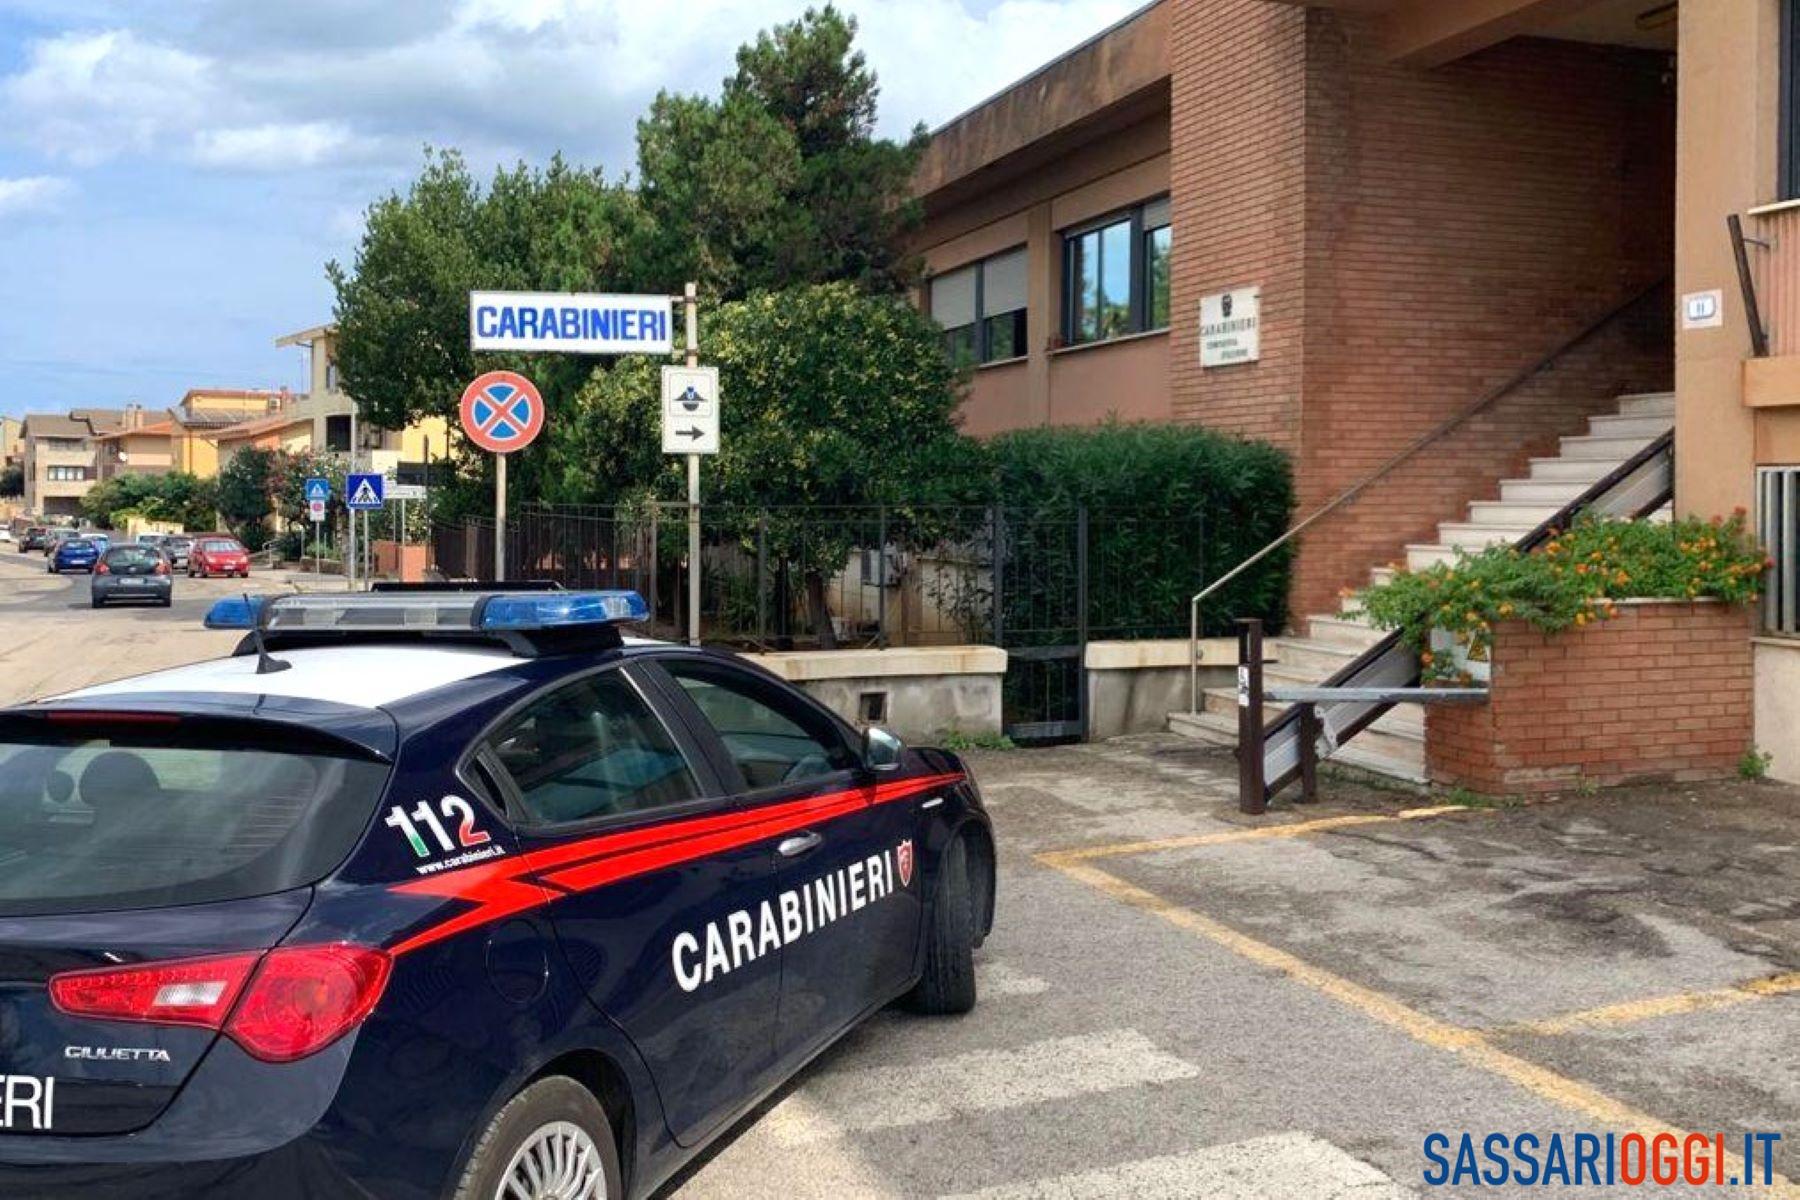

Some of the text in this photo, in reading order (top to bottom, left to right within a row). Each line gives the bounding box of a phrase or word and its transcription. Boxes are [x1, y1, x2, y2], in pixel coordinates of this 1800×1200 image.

[476, 306, 667, 341] CARABINIERI
[384, 794, 492, 858] 112
[672, 850, 894, 993] CARABINIERI
[64, 1045, 171, 1063] GIULIETTA
[0, 1074, 55, 1130] RI
